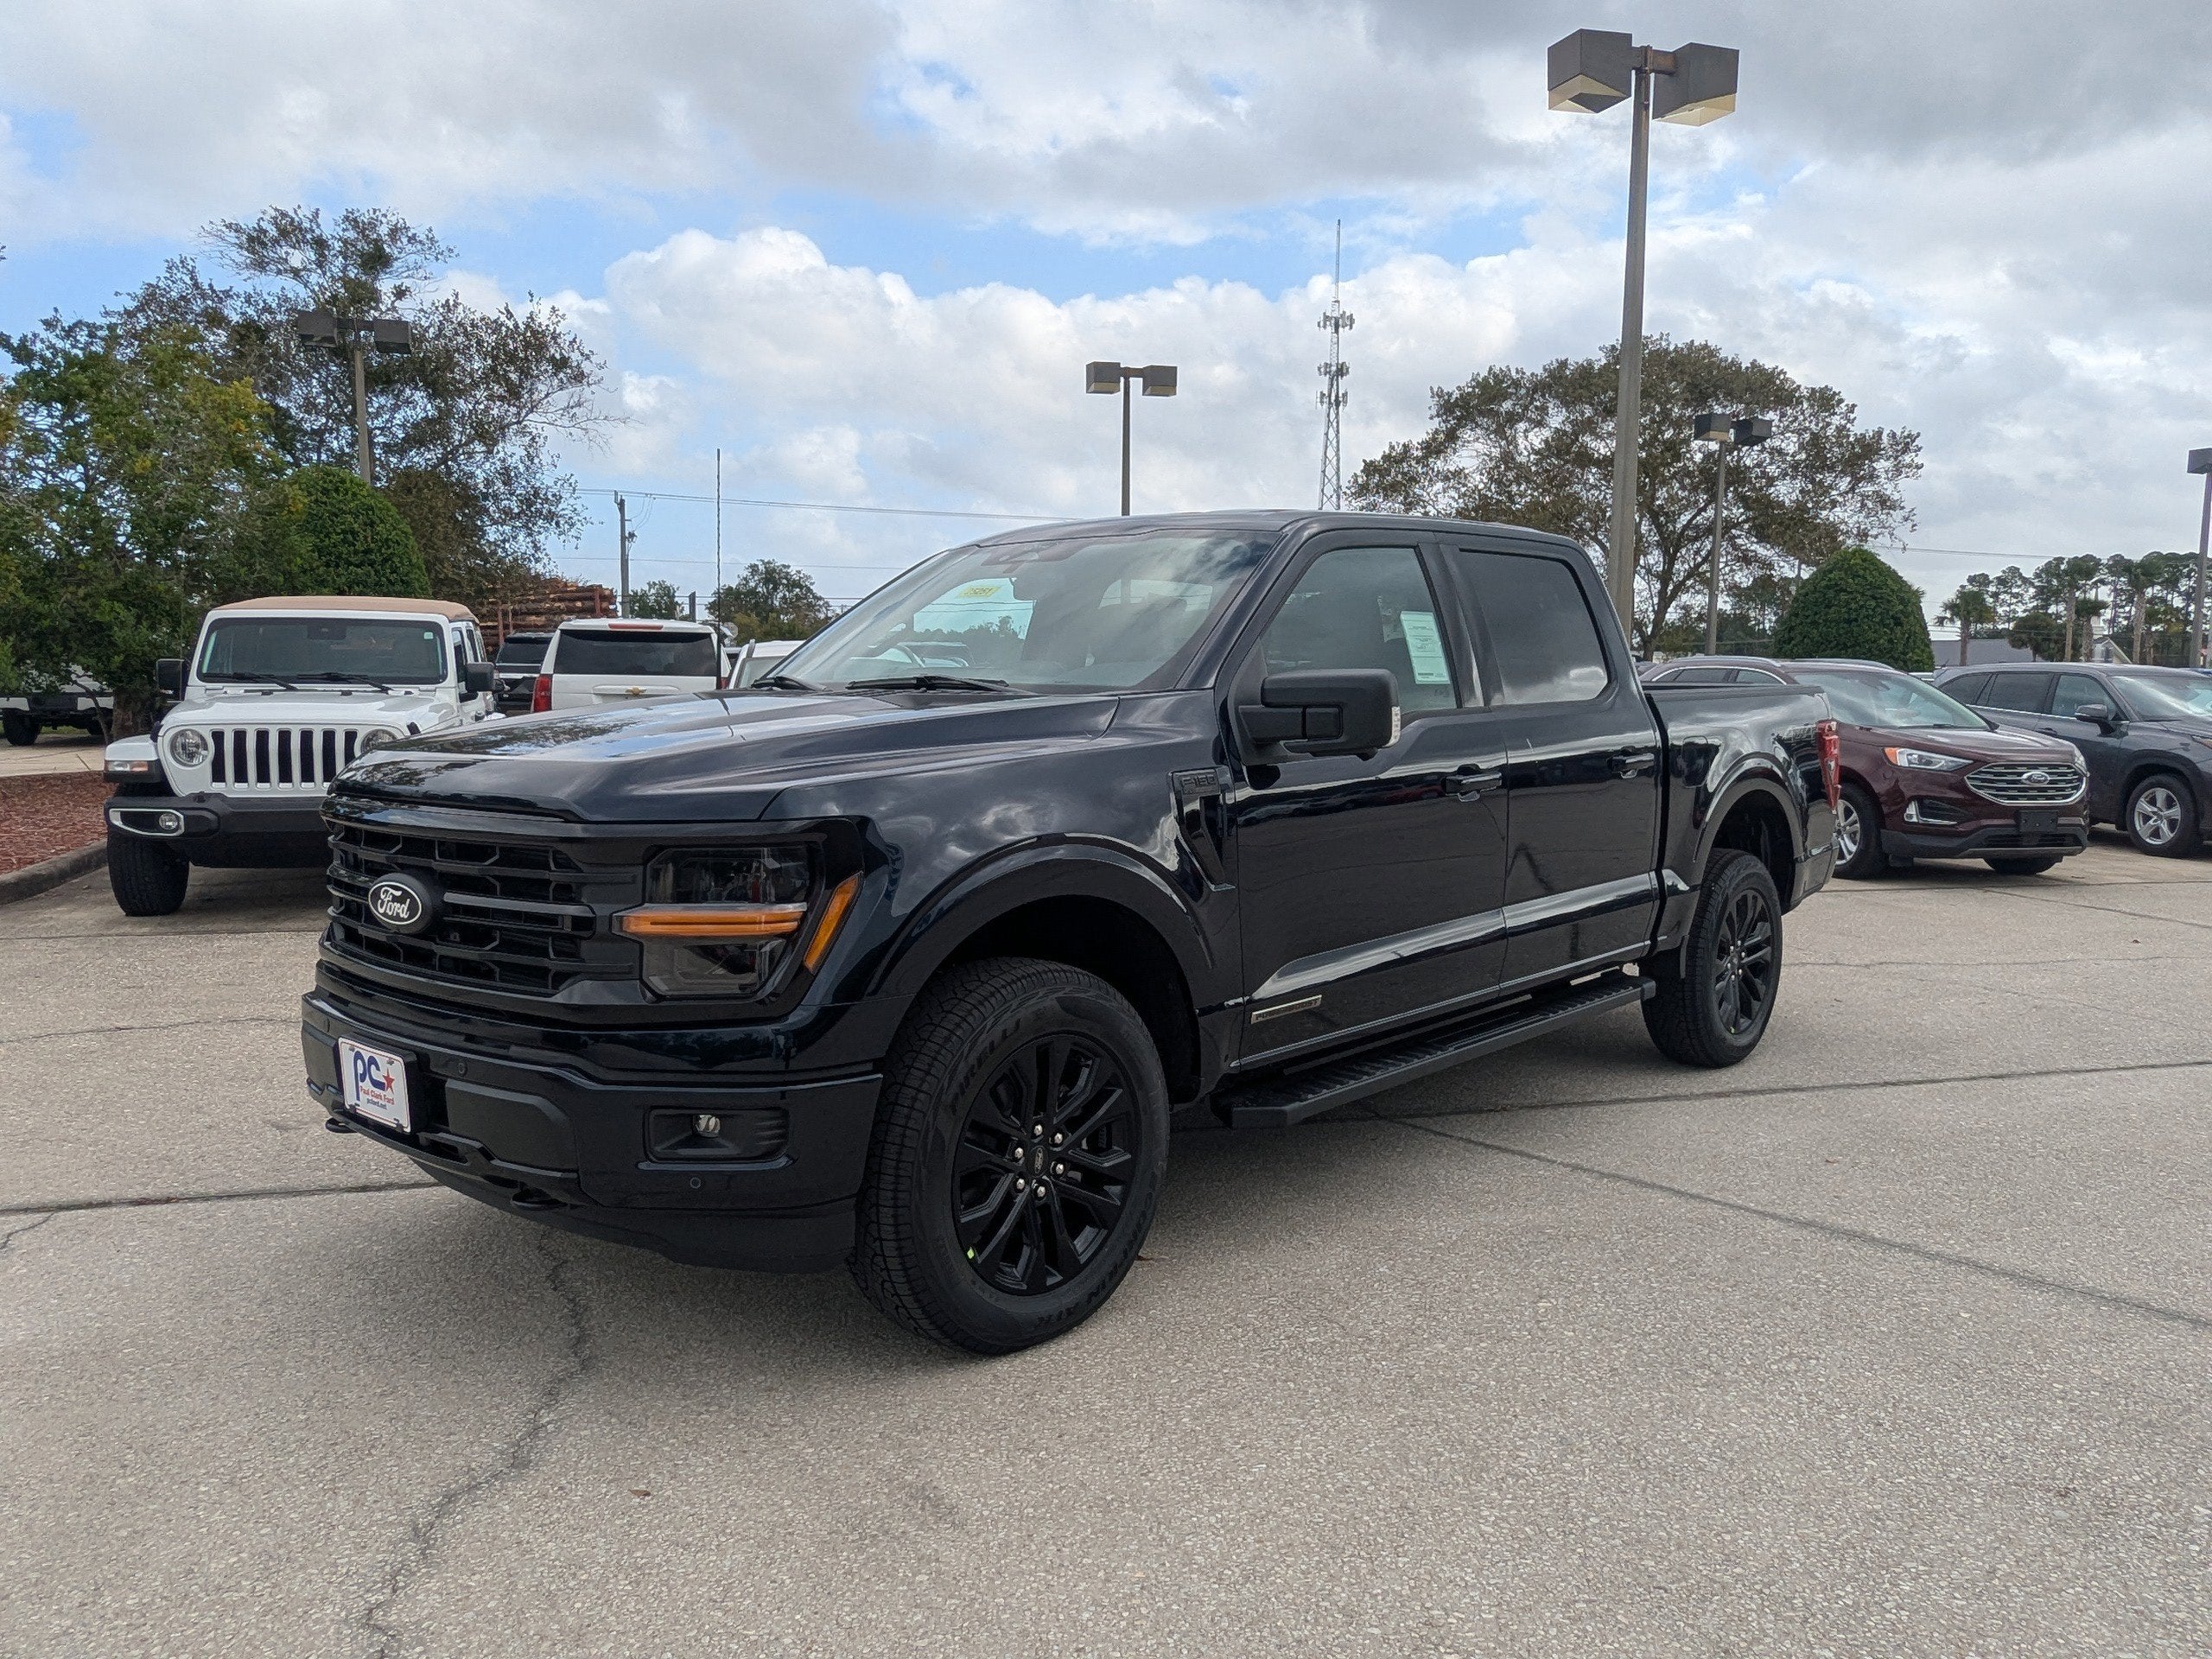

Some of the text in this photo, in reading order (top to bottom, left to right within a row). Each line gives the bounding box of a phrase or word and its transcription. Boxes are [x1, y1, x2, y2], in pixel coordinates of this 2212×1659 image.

[378, 887, 410, 918] Ford
[359, 1085, 395, 1105] Paul Clark Ford
